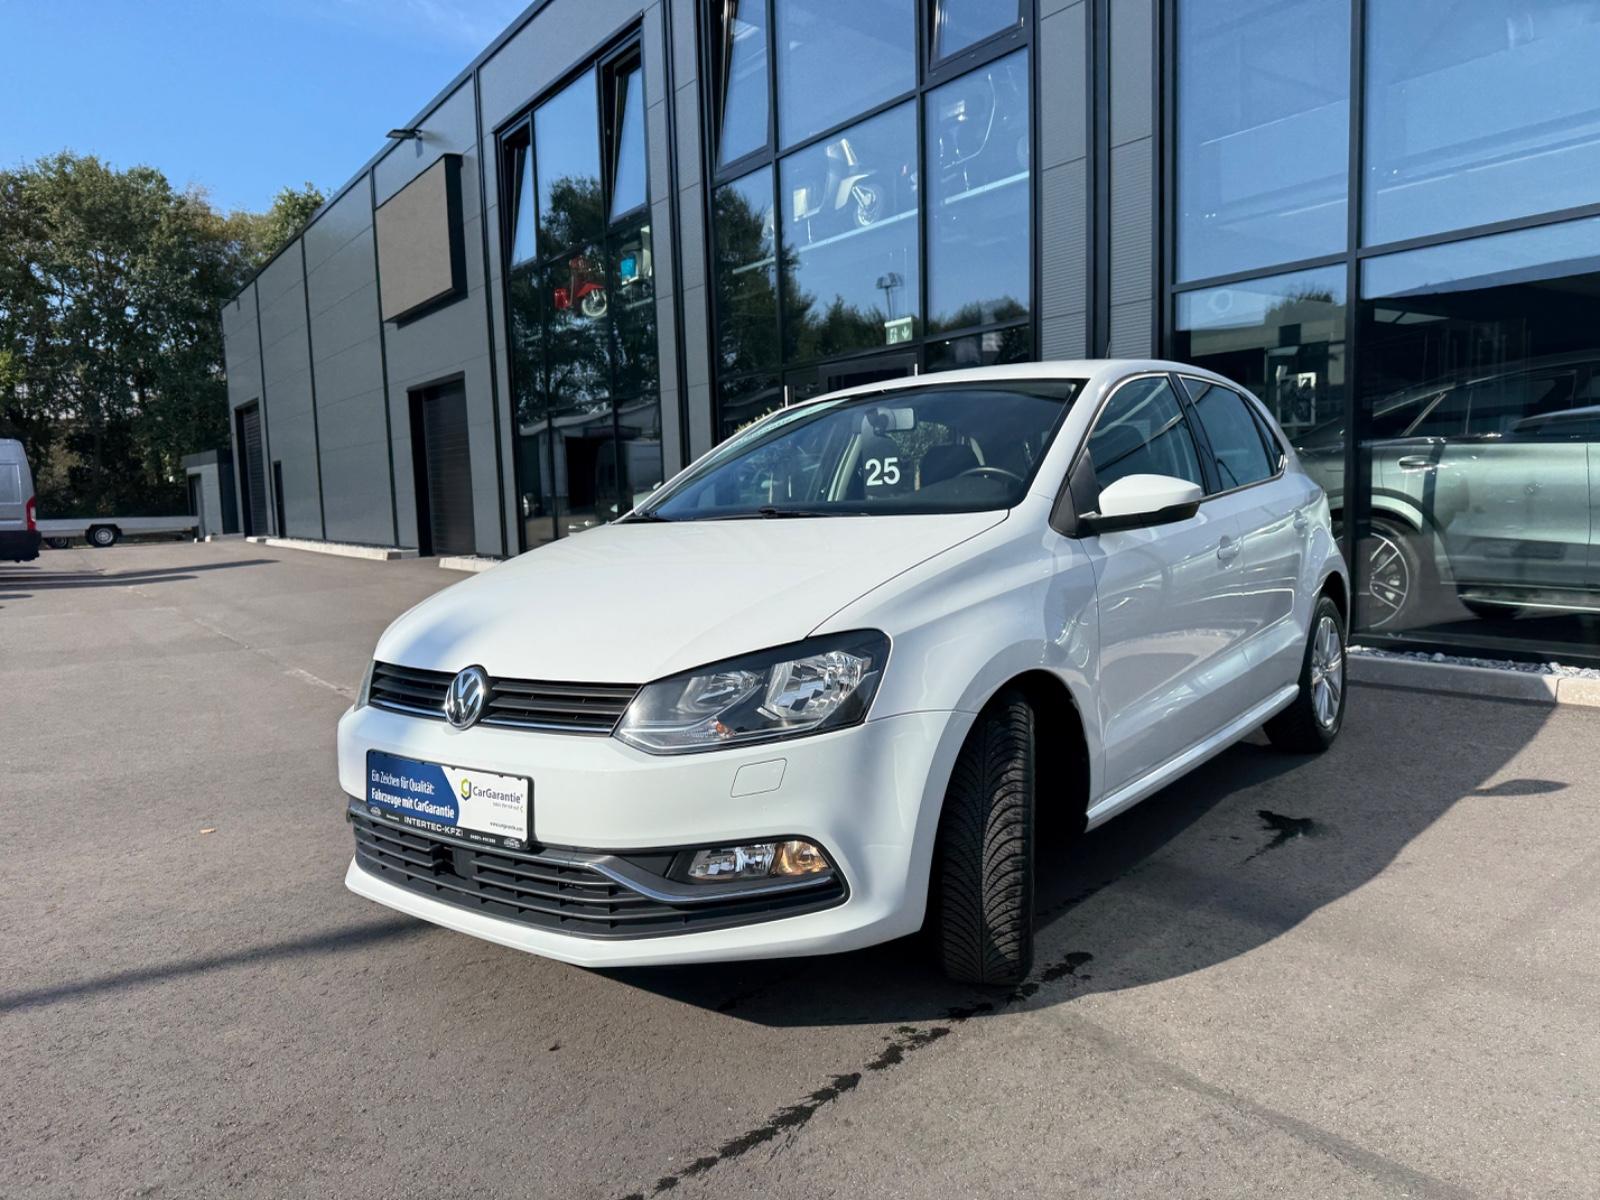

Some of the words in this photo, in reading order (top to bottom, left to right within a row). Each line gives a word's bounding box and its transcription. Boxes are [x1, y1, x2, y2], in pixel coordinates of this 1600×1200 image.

[865, 457, 900, 486] 25
[371, 769, 380, 782] Ein
[380, 771, 400, 787] Zeichen
[400, 775, 409, 789] für
[409, 778, 435, 795] Qualität:
[473, 786, 521, 804] CarGarantie
[371, 787, 402, 809] Fahrzeuge
[402, 796, 414, 809] mit
[414, 798, 455, 819] CarGarantie
